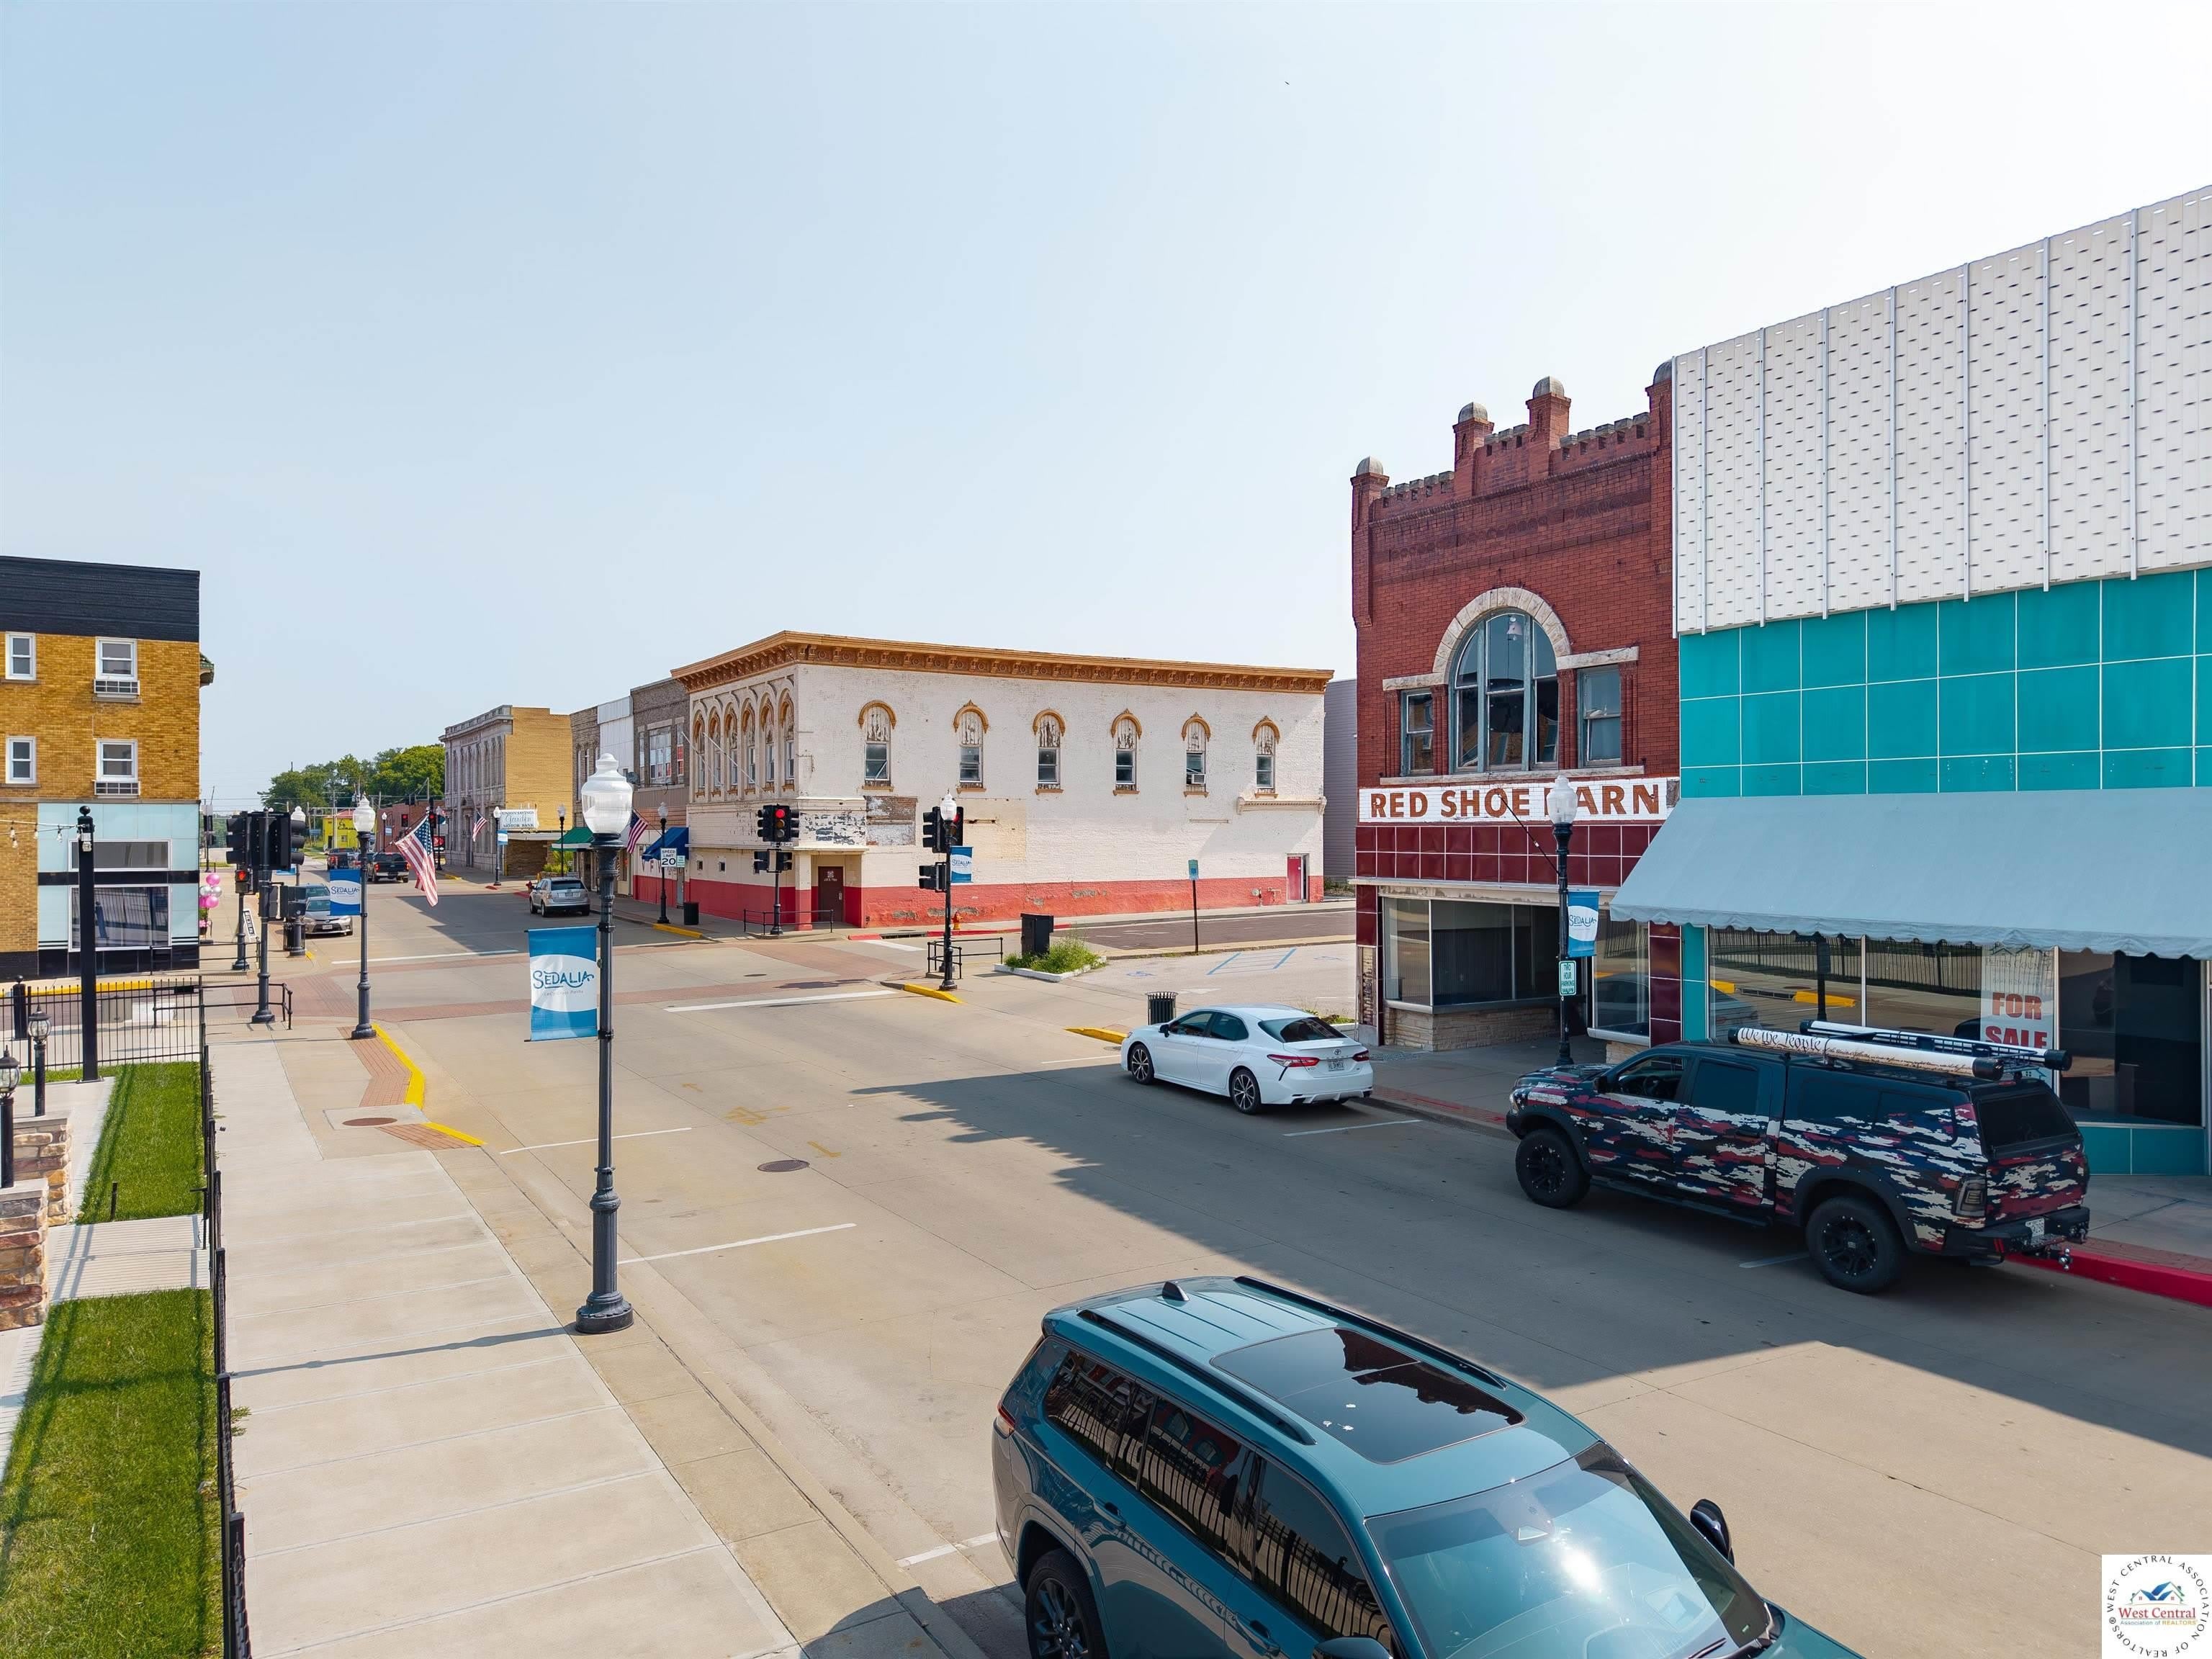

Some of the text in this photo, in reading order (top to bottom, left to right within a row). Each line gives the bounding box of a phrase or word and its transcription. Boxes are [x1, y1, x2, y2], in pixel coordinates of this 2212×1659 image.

[1371, 784, 1659, 818] RED SHOE ARN
[1569, 914, 1597, 927] SEDALIA
[533, 970, 595, 989] SEDALIA
[1992, 992, 2041, 1020] FOR
[1741, 1028, 1821, 1053] We the People
[1985, 1025, 2048, 1048] SALE
